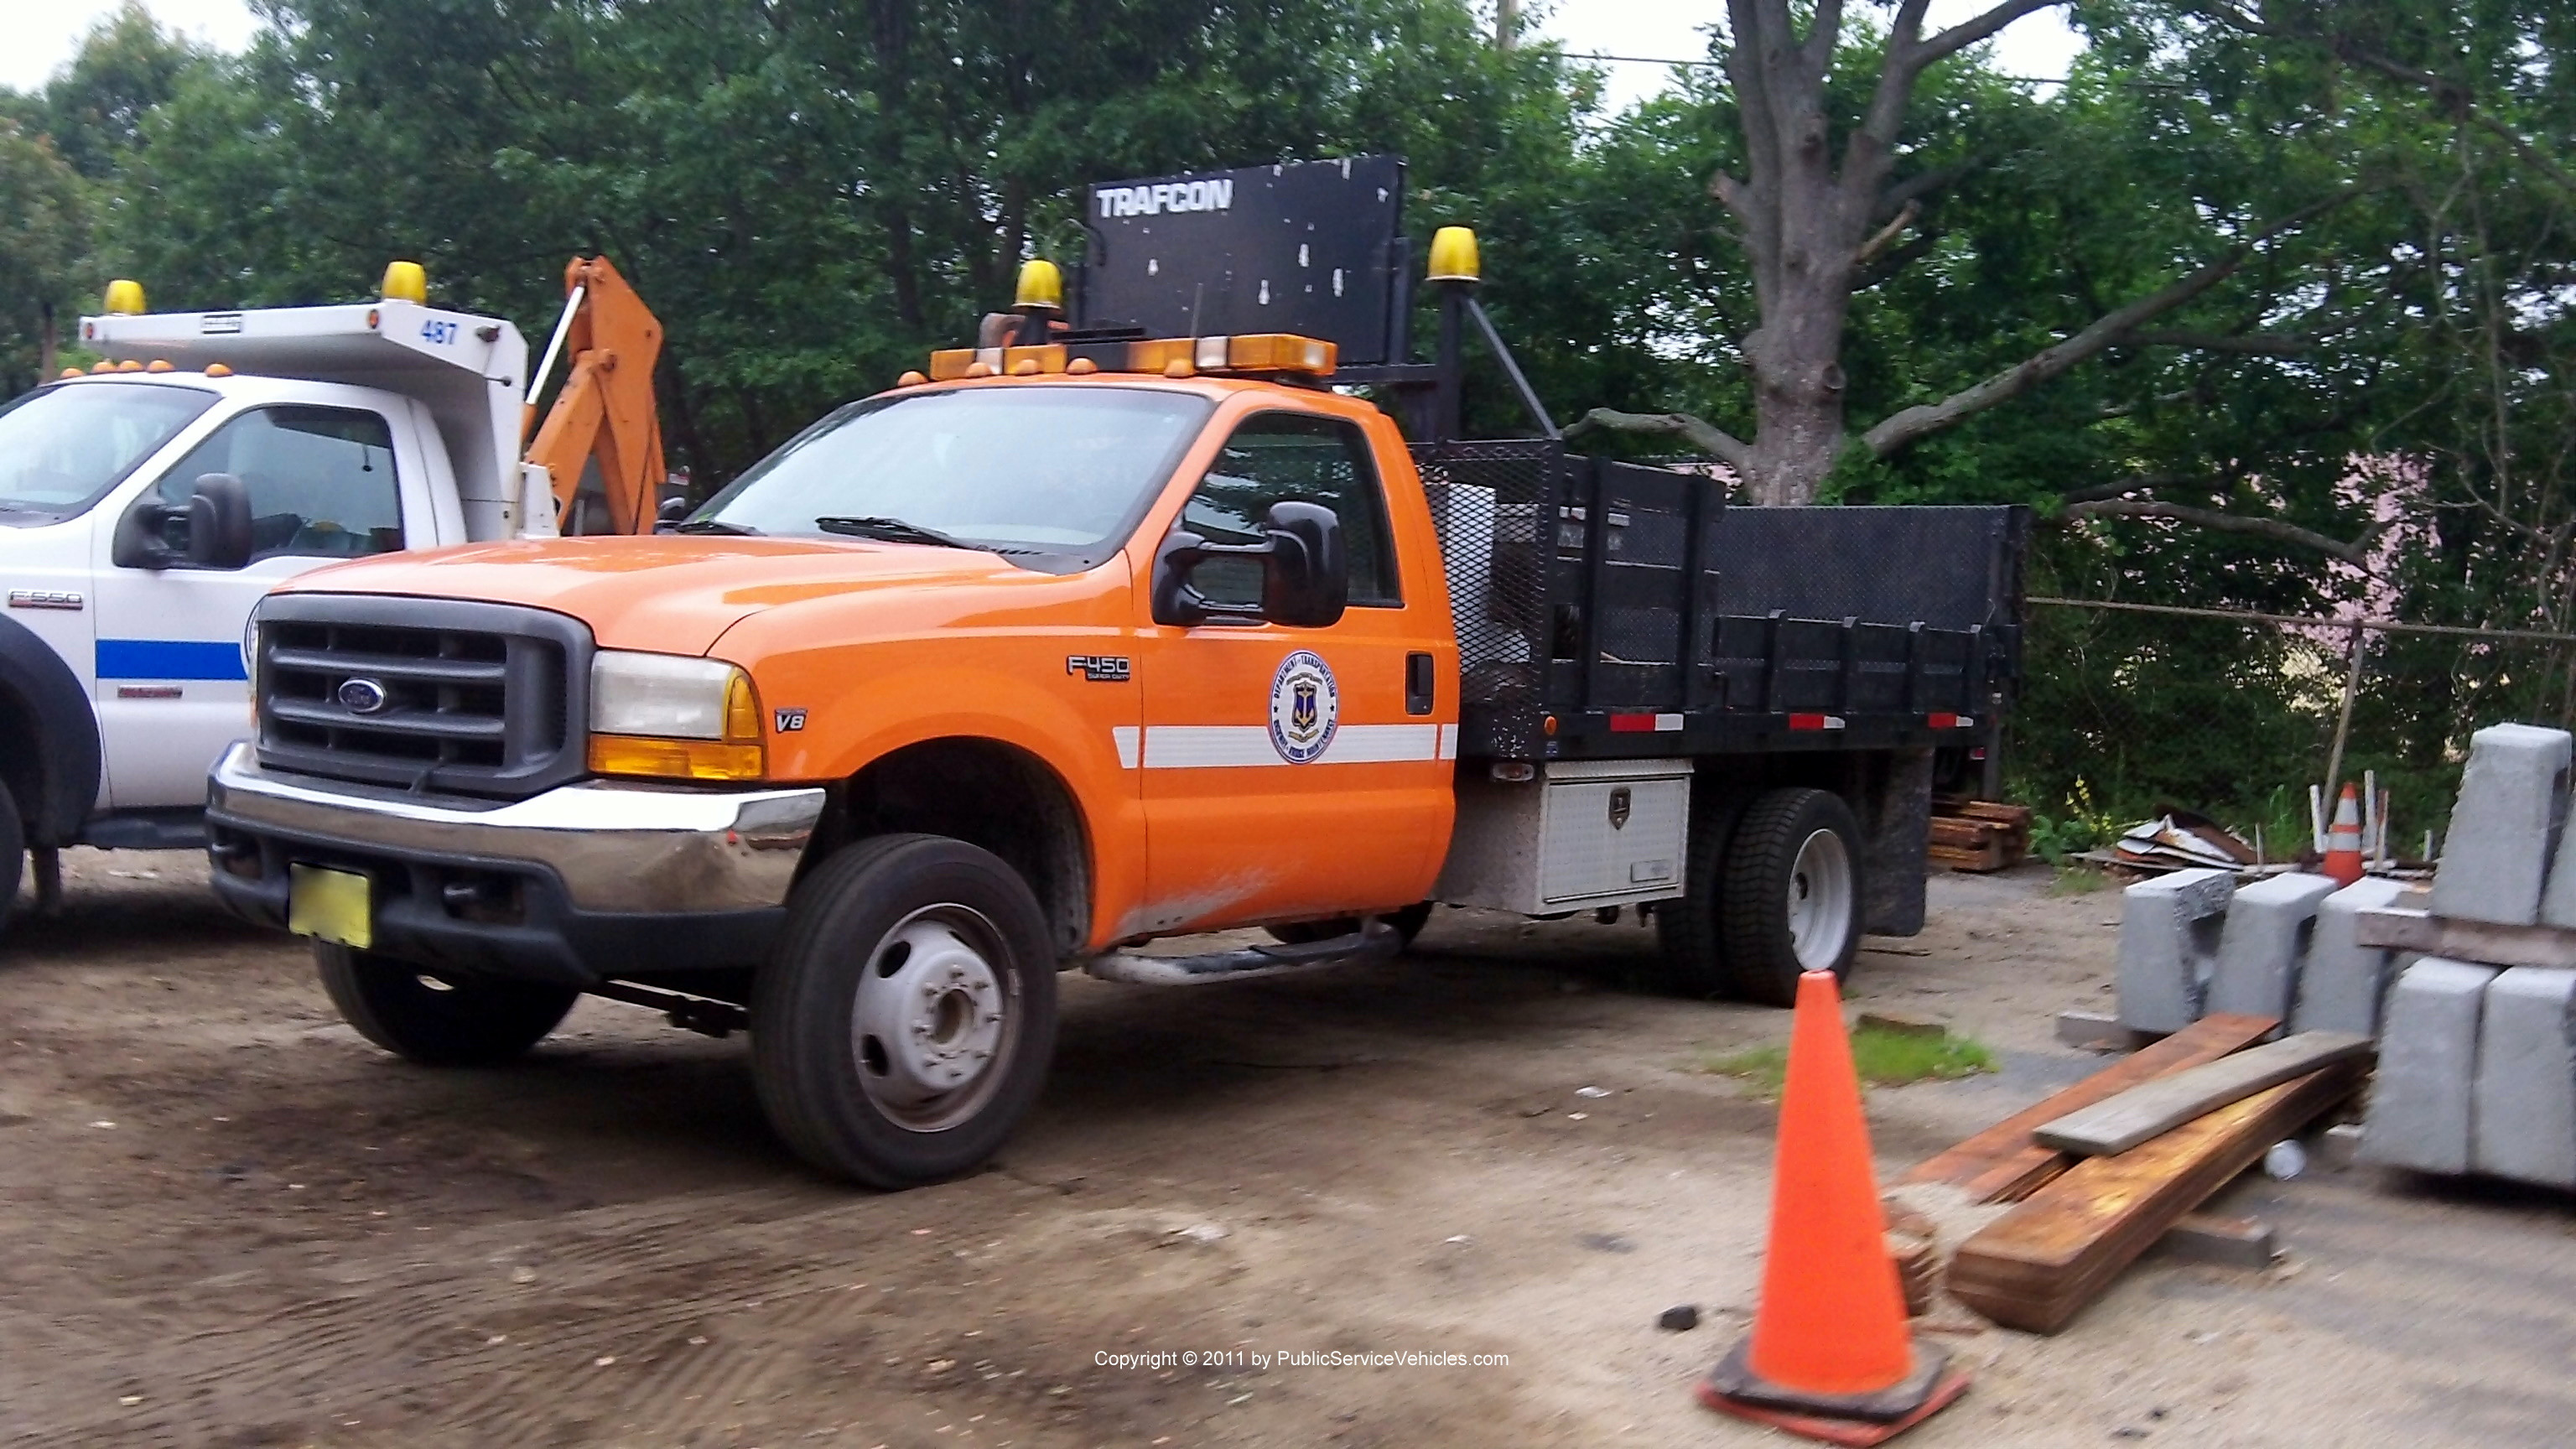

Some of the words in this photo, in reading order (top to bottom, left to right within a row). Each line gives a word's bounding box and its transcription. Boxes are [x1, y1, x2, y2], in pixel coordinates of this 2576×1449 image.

[1095, 179, 1233, 218] TRAFCON
[421, 319, 457, 345] 487
[776, 714, 805, 732] V8
